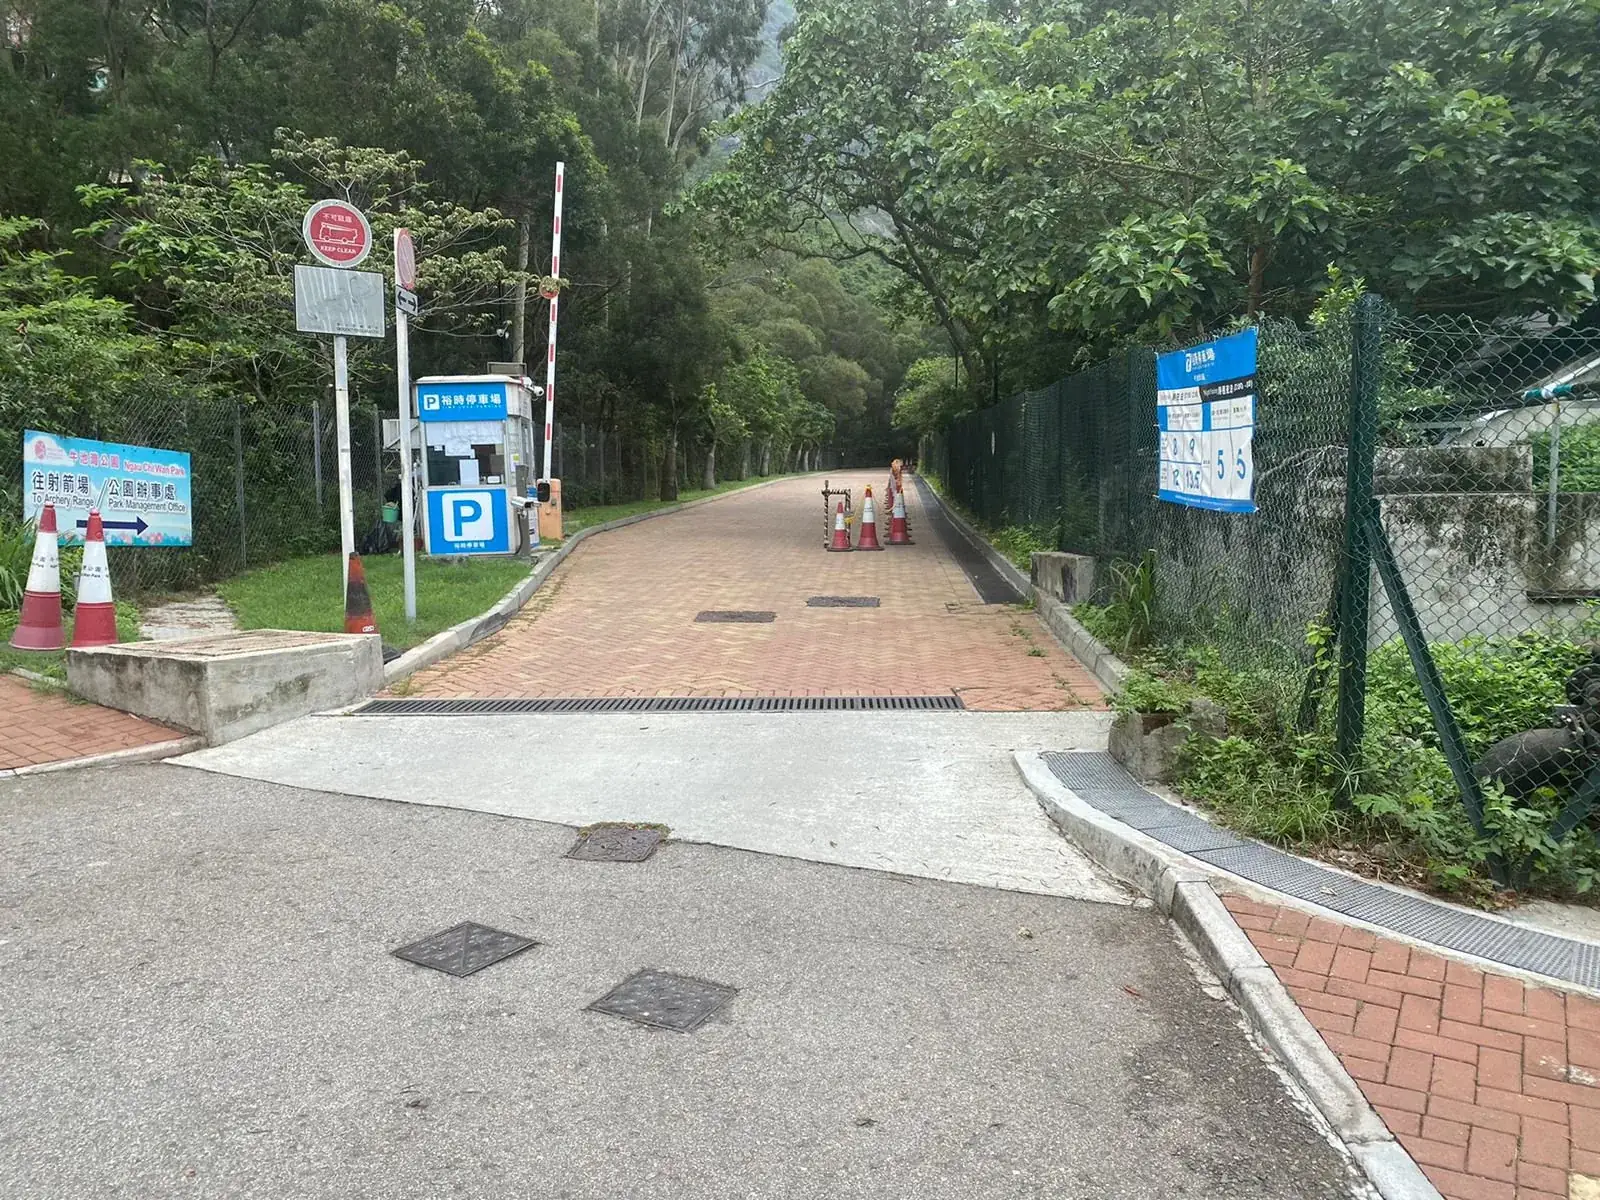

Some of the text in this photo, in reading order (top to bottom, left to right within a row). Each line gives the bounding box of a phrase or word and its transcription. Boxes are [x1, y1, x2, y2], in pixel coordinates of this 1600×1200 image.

[337, 246, 357, 254] CLEAR
[441, 393, 502, 406] 裕時停車場
[1189, 438, 1196, 457] 9
[125, 461, 141, 472] Ngau
[154, 464, 170, 474] Wan
[170, 466, 185, 476] Park
[1217, 449, 1225, 480] 5
[1236, 448, 1247, 480] 5
[32, 471, 89, 494] 往射箭場
[109, 479, 175, 500] 公園辦事處
[32, 492, 94, 508] To Archery Range
[108, 498, 187, 512] Park Management Office
[452, 500, 482, 537] P
